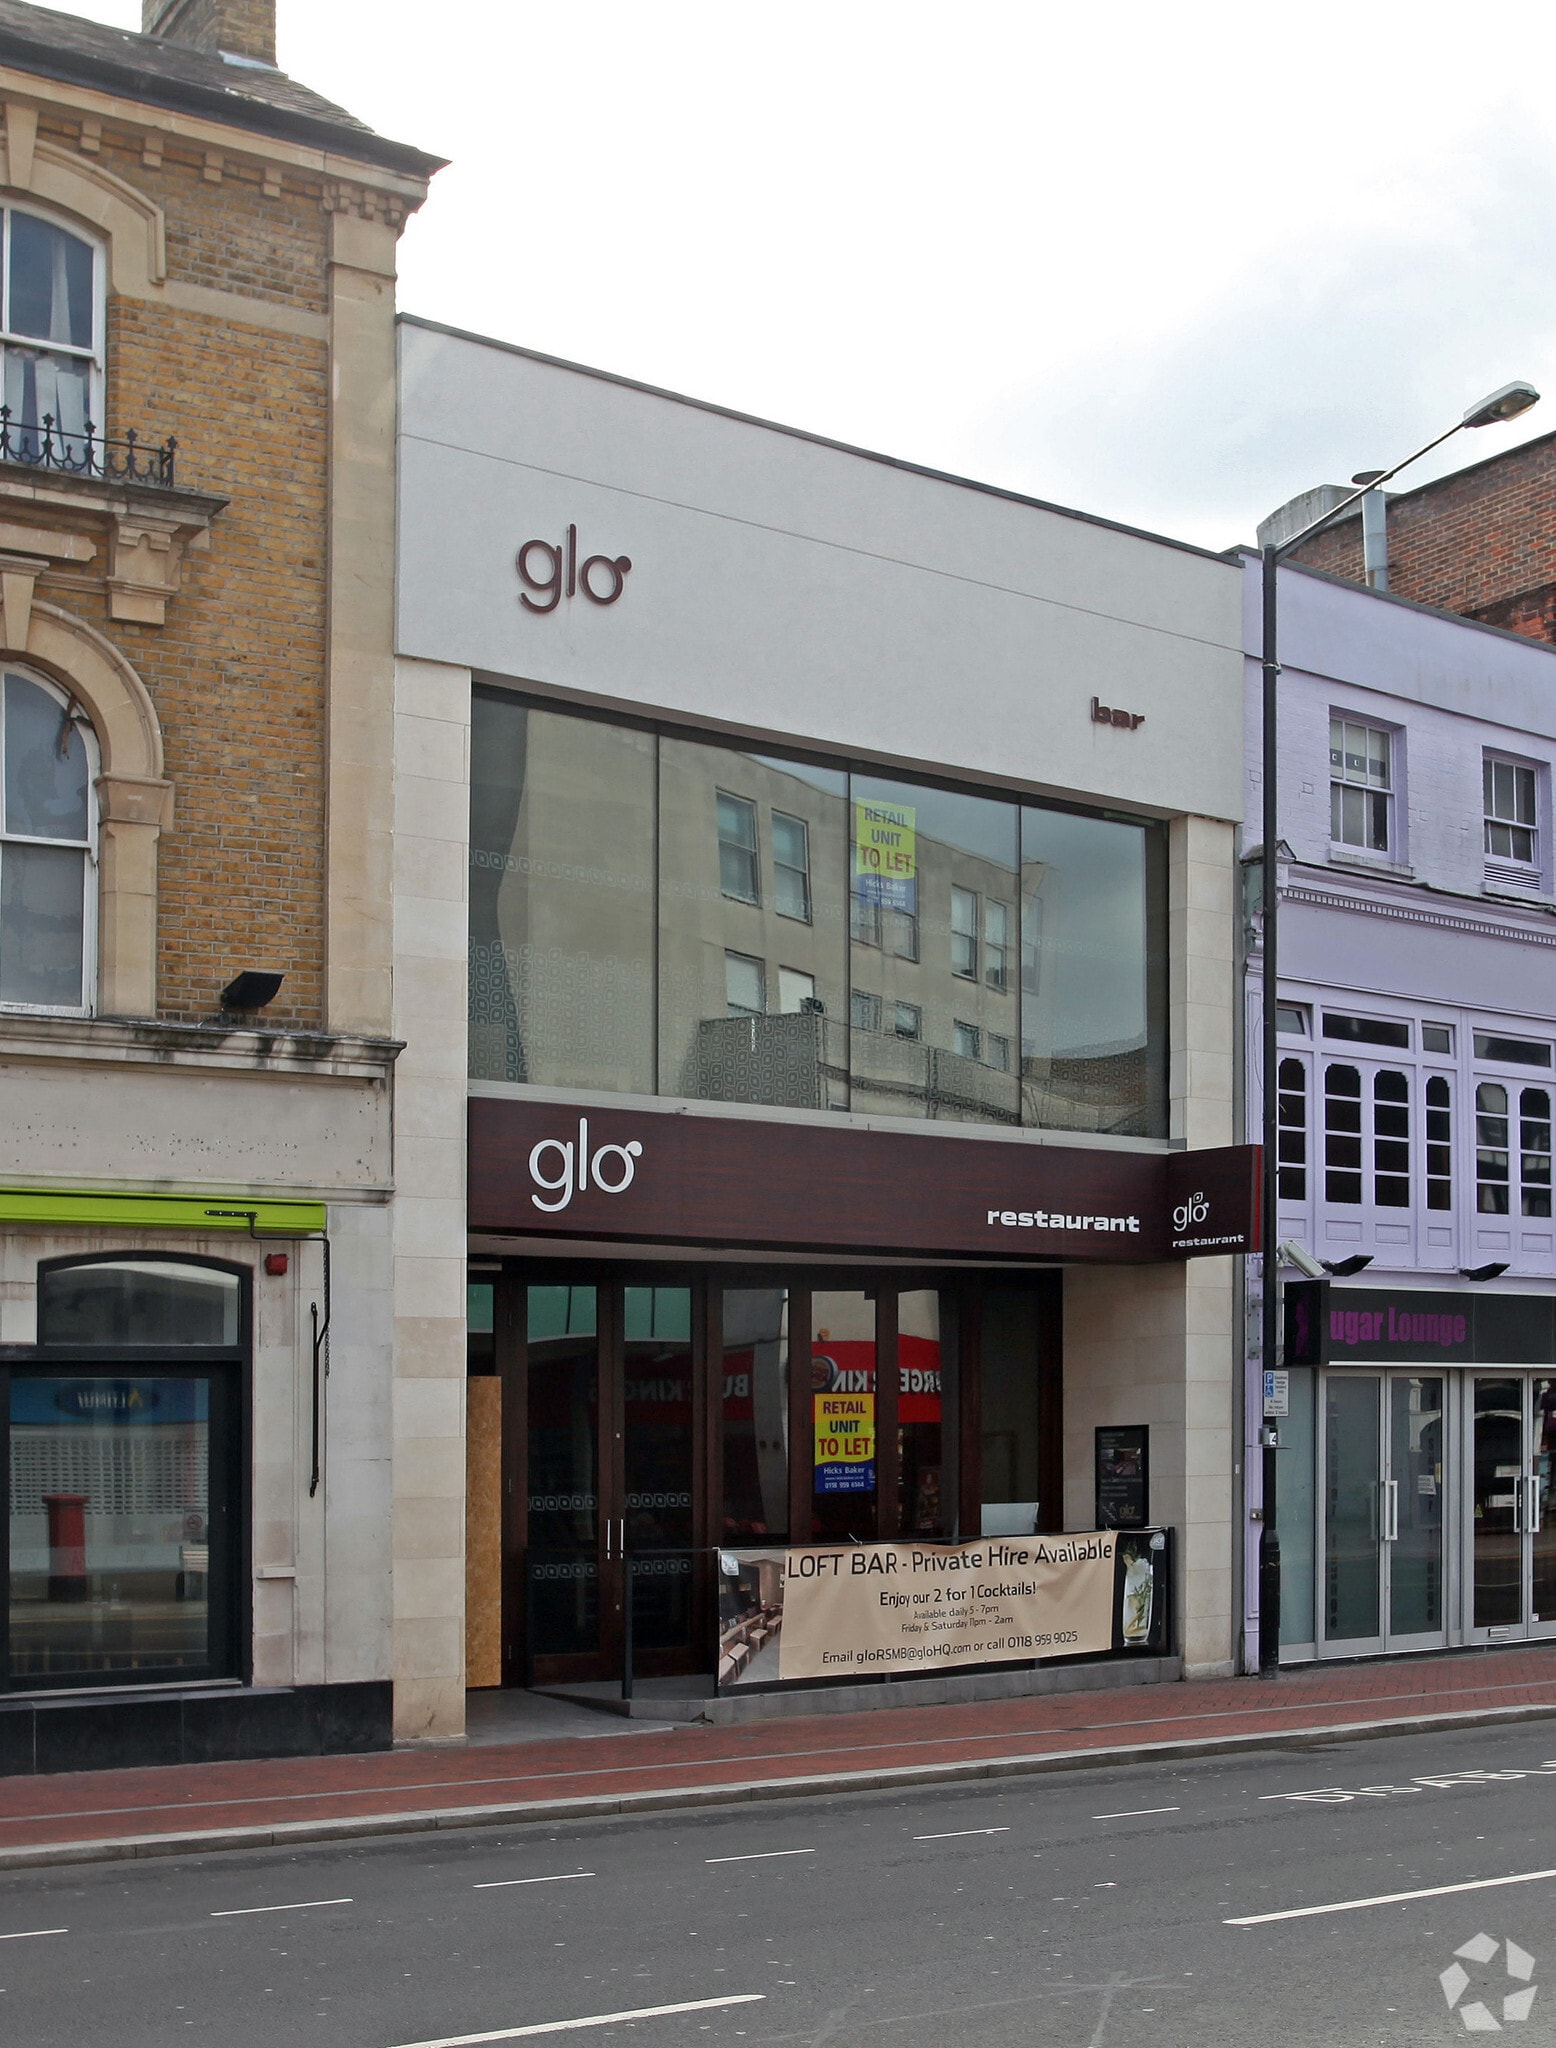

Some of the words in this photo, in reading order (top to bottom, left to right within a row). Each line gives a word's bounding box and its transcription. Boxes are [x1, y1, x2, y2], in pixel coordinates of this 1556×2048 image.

[516, 523, 632, 614] glo
[1091, 696, 1145, 731] bar
[865, 807, 907, 828] RETAIL
[871, 828, 902, 847] UNIT
[861, 847, 880, 868] TO
[886, 851, 912, 873] LET
[528, 1117, 643, 1213] glo
[987, 1209, 1140, 1234] restaurant
[1172, 1197, 1210, 1232] glo
[1172, 1233, 1245, 1248] restaurant
[1330, 1309, 1385, 1345] ugar
[1387, 1306, 1467, 1347] Lounge
[823, 1401, 867, 1415] RETAIL
[829, 1420, 860, 1433] UNIT
[818, 1437, 839, 1456] TO
[844, 1437, 870, 1456] LET
[823, 1466, 842, 1475] Hicks
[844, 1466, 865, 1474] Baker
[788, 1553, 844, 1578] LOFT
[851, 1552, 898, 1575] BAR
[912, 1550, 983, 1573] Private
[988, 1545, 1029, 1567] Hire
[1034, 1538, 1112, 1564] Available
[879, 1591, 910, 1608] Enjoy
[912, 1592, 930, 1604] our
[933, 1588, 942, 1602] 2
[946, 1587, 967, 1601] for
[977, 1581, 1036, 1599] Cocktails!
[901, 1623, 922, 1634] Friday
[923, 1622, 929, 1632] &
[932, 1619, 968, 1631] Saturday
[994, 1615, 1013, 1625] 2am
[914, 1608, 947, 1620] Available
[949, 1606, 968, 1618] daily
[969, 1606, 975, 1615] 5
[980, 1604, 999, 1616] 7pm
[822, 1649, 853, 1664] Email
[856, 1643, 971, 1663] gloRSMB@gloHQ.com
[973, 1642, 984, 1651] or
[986, 1637, 1005, 1650] call
[1007, 1635, 1033, 1649] 0118
[1034, 1633, 1052, 1646] 959
[1053, 1630, 1078, 1644] 9025
[1285, 1760, 1556, 1803] DISABL
